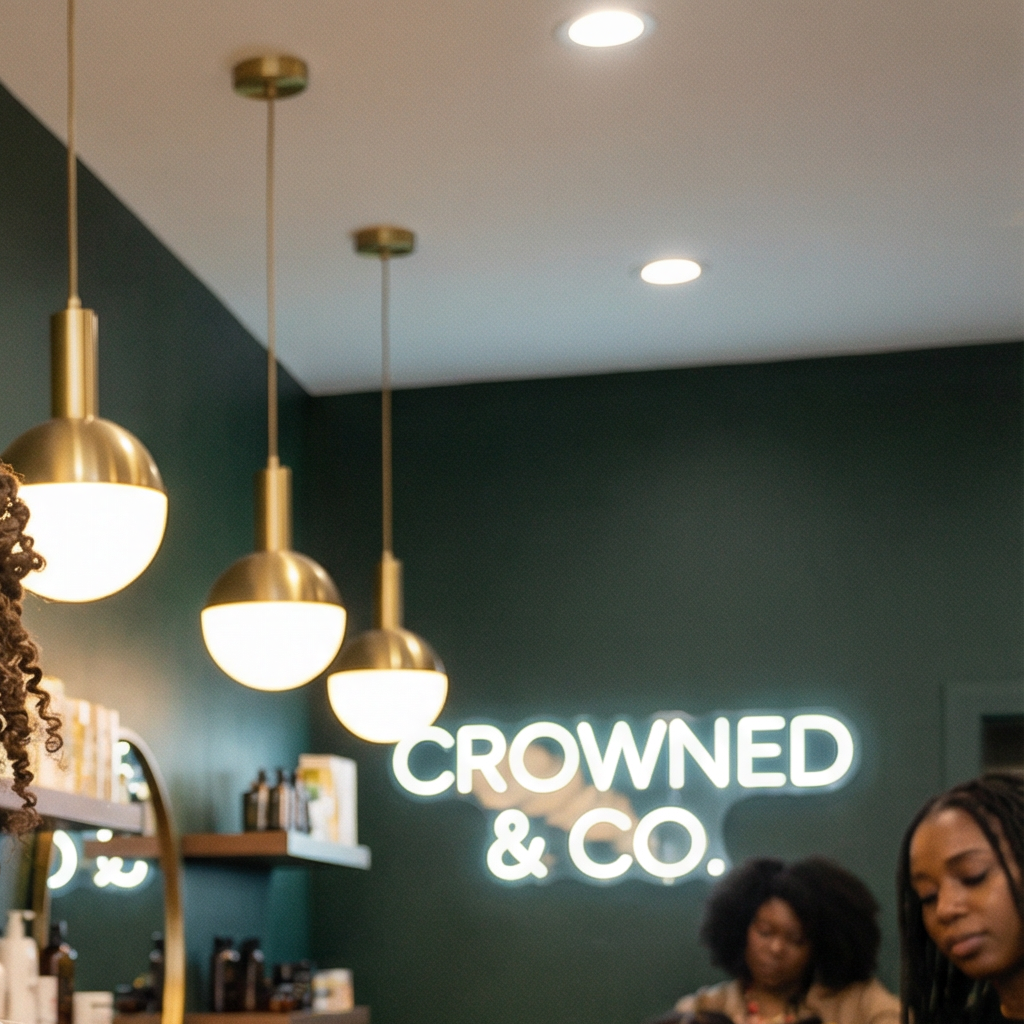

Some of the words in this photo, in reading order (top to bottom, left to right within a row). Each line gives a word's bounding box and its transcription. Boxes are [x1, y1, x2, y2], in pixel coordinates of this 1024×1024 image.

[392, 714, 854, 796] CROWNED
[486, 808, 549, 881] &
[568, 806, 726, 879] CO.
